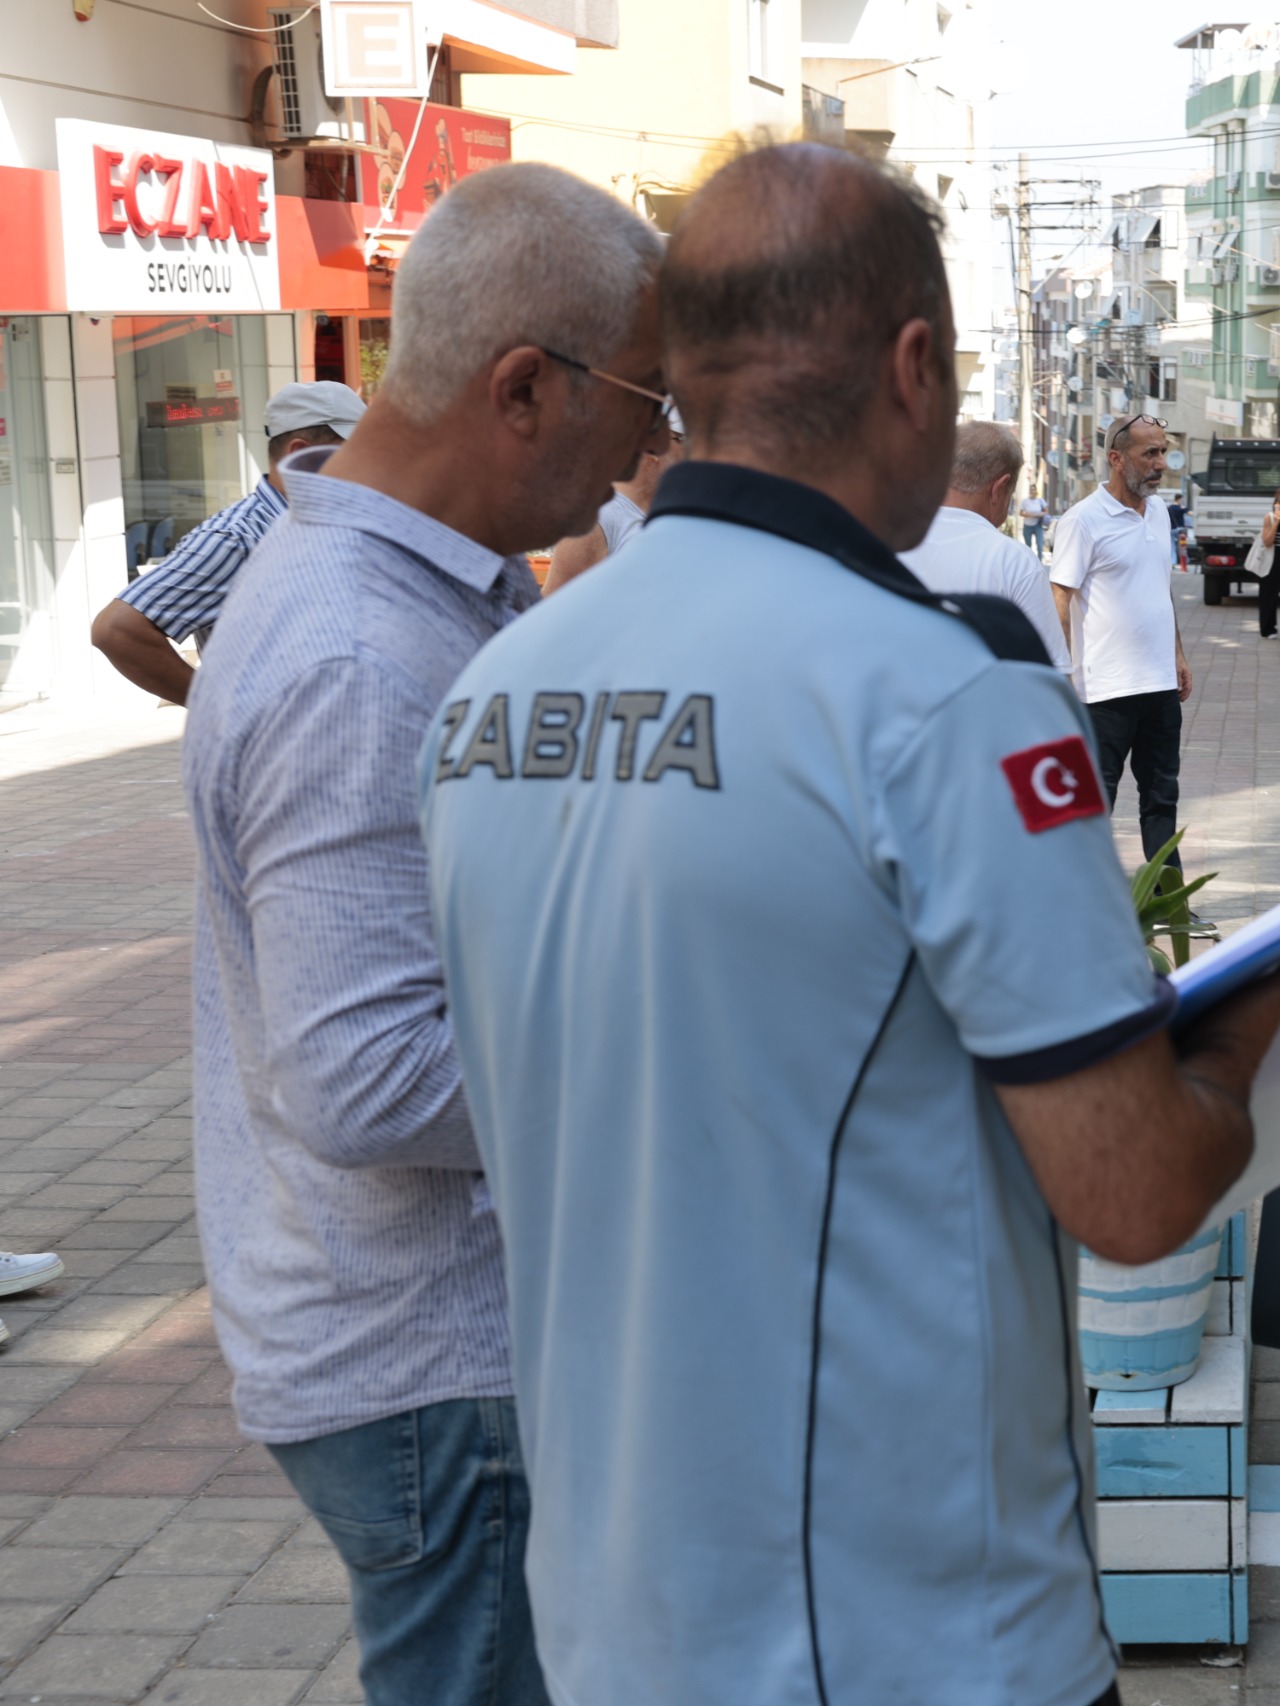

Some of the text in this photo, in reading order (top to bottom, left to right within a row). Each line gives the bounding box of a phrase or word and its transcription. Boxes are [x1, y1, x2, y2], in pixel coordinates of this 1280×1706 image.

[345, 13, 402, 78] E
[93, 144, 271, 243] ECZANE
[148, 256, 231, 293] SEVGİYOLU
[436, 690, 722, 791] ZABITA
